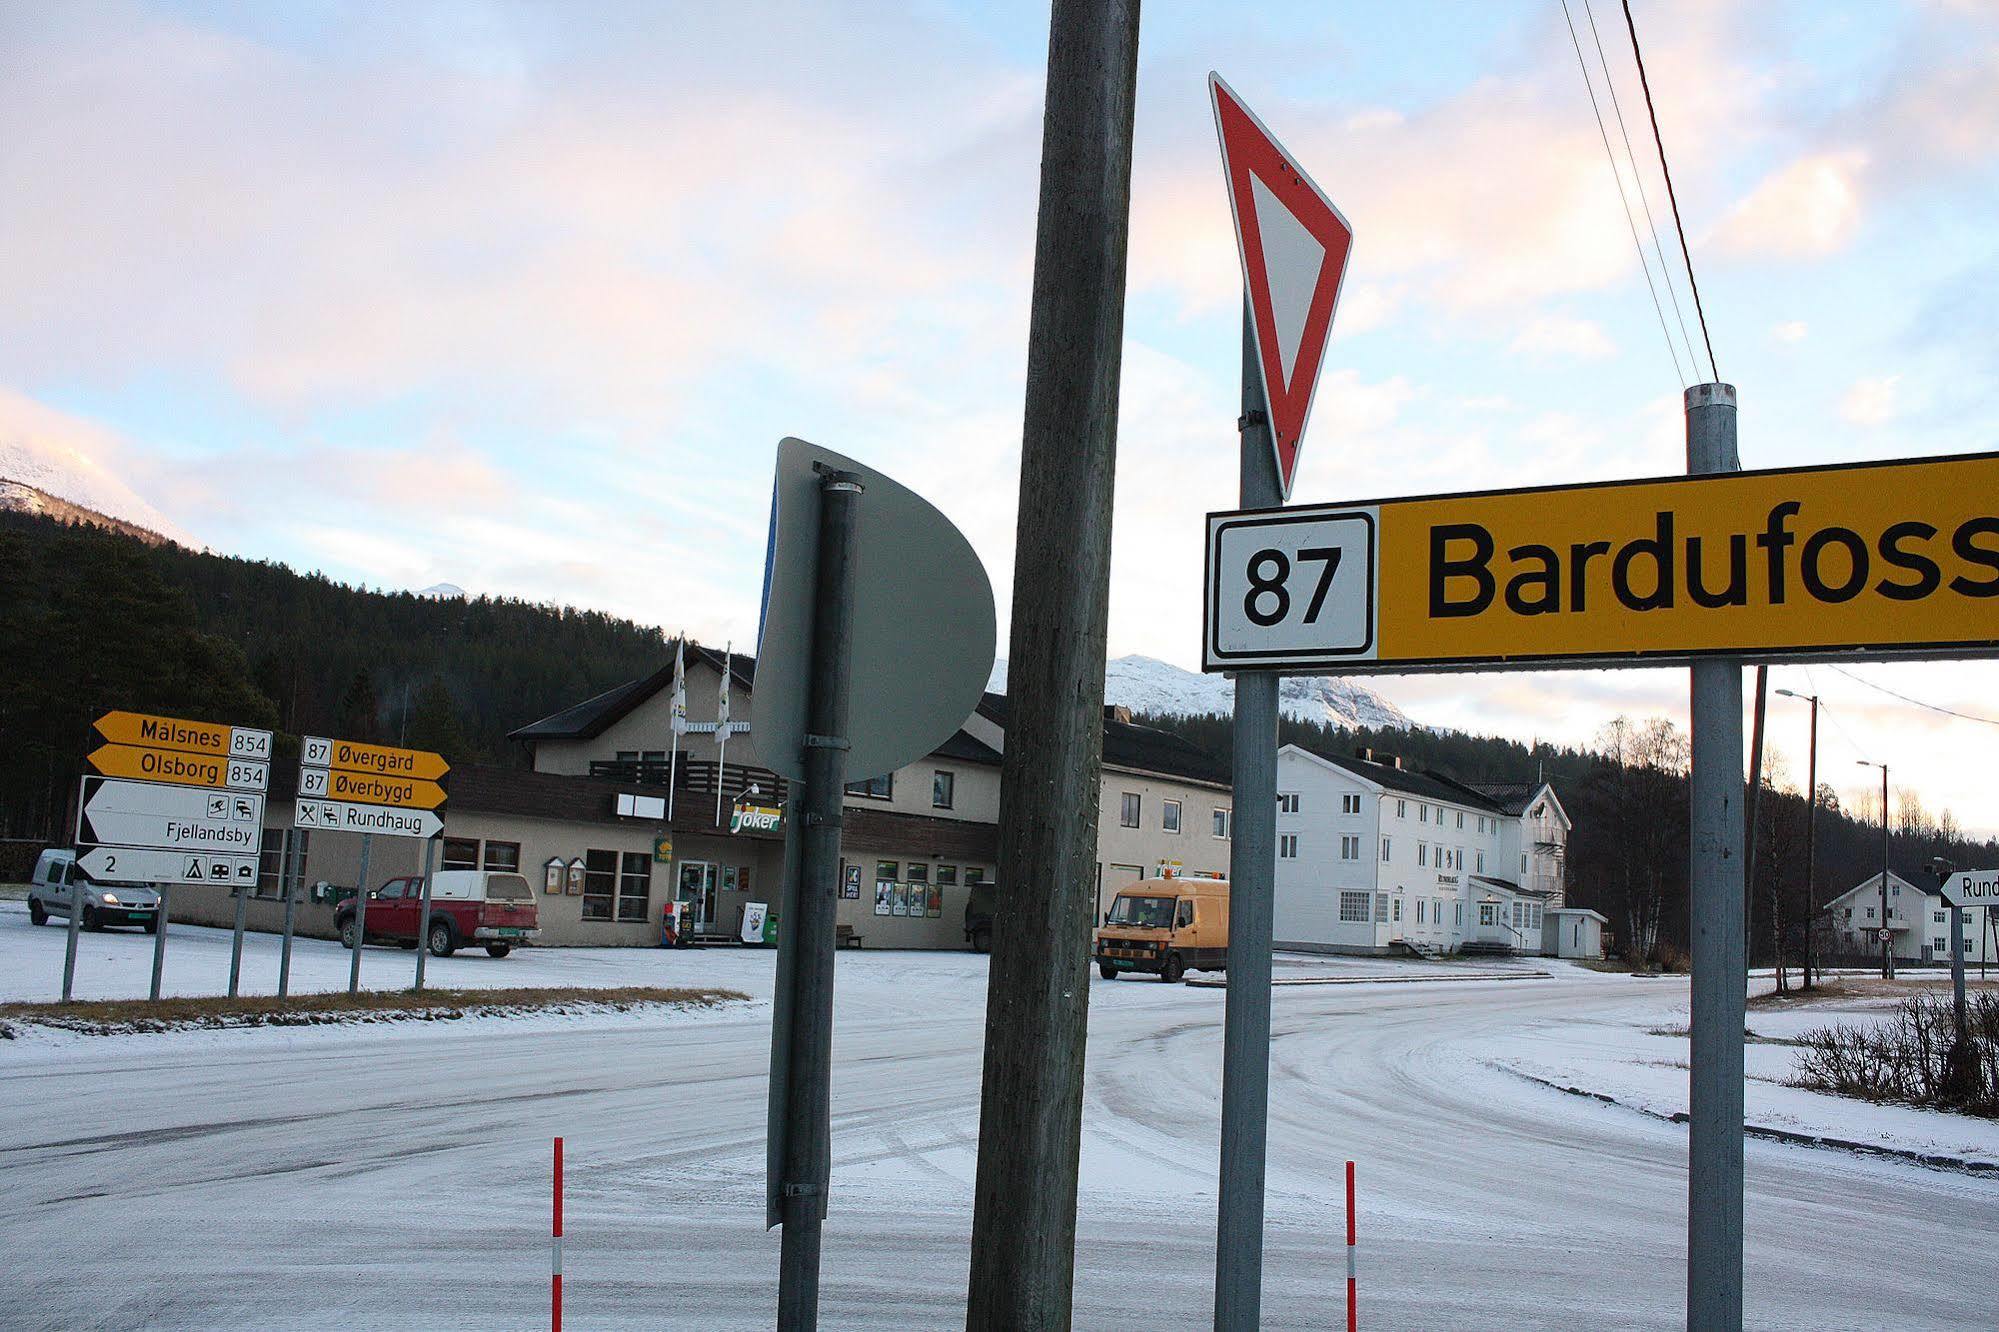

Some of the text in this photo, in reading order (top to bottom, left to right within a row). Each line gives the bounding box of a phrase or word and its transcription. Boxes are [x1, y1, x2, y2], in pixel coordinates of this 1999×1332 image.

[1428, 501, 1999, 619] Bardufoss
[1244, 547, 1342, 626] 87
[141, 719, 221, 747] Målsnes
[234, 735, 266, 752] 854
[308, 744, 327, 759] 87
[338, 745, 414, 771] Øvergård
[141, 753, 218, 784] Olsborg
[231, 766, 263, 783] 854
[305, 774, 324, 790] 87
[335, 775, 413, 802] Øverbygd
[346, 808, 422, 834] Rundhaug
[166, 822, 252, 846] Fjellandsby
[105, 856, 116, 872] 2
[1962, 875, 1999, 898] Rund
